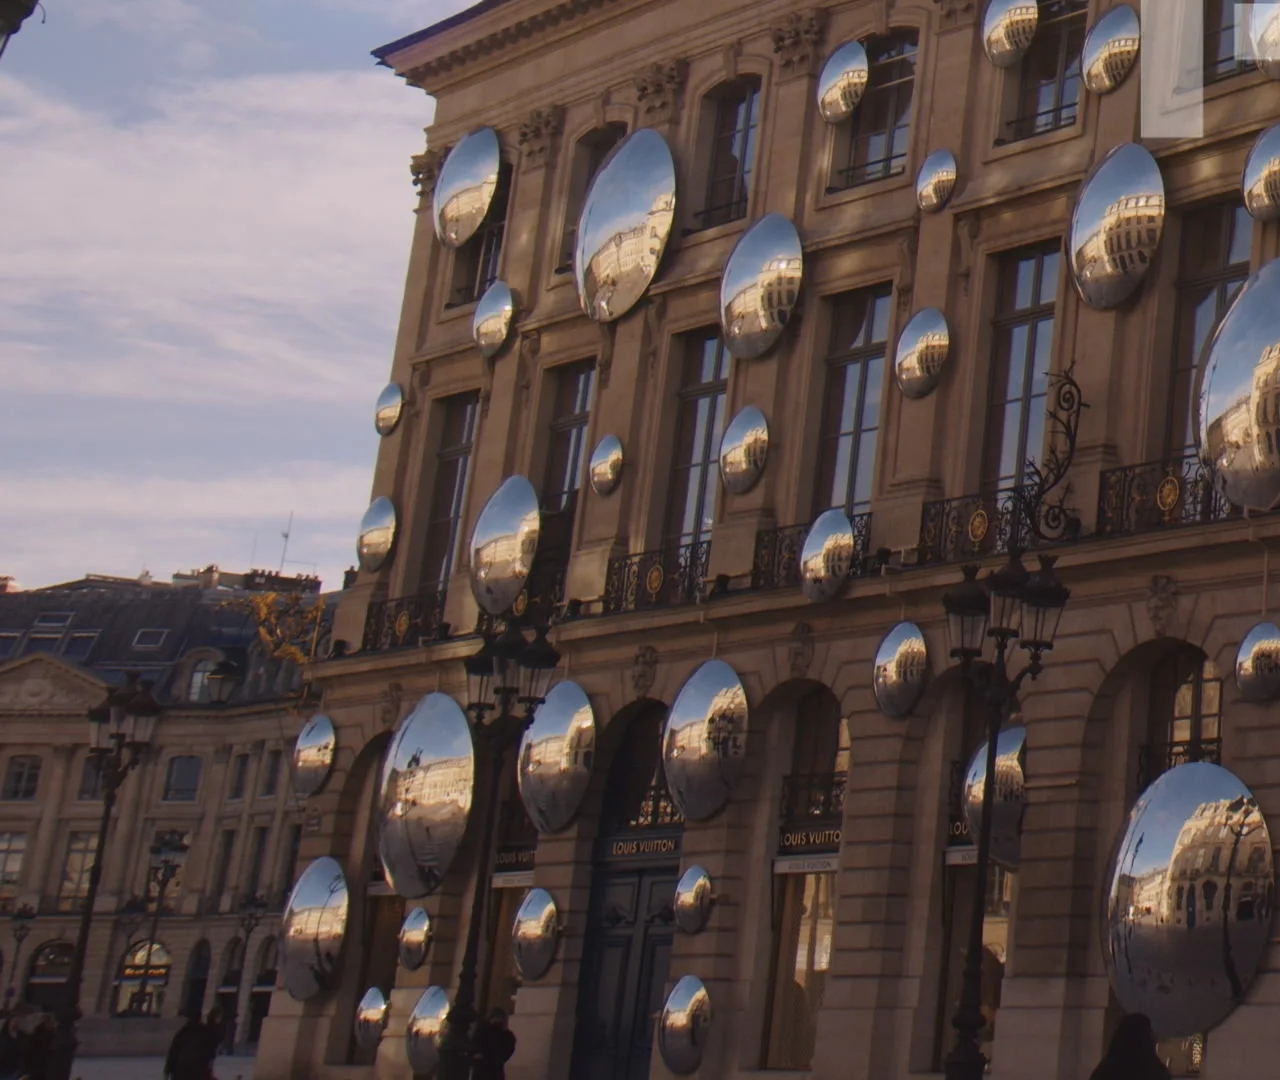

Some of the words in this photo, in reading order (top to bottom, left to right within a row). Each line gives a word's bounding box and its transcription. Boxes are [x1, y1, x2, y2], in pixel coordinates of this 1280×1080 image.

[780, 831, 806, 846] LOUIS
[612, 841, 637, 855] LOUIS
[640, 839, 675, 853] VUITTON
